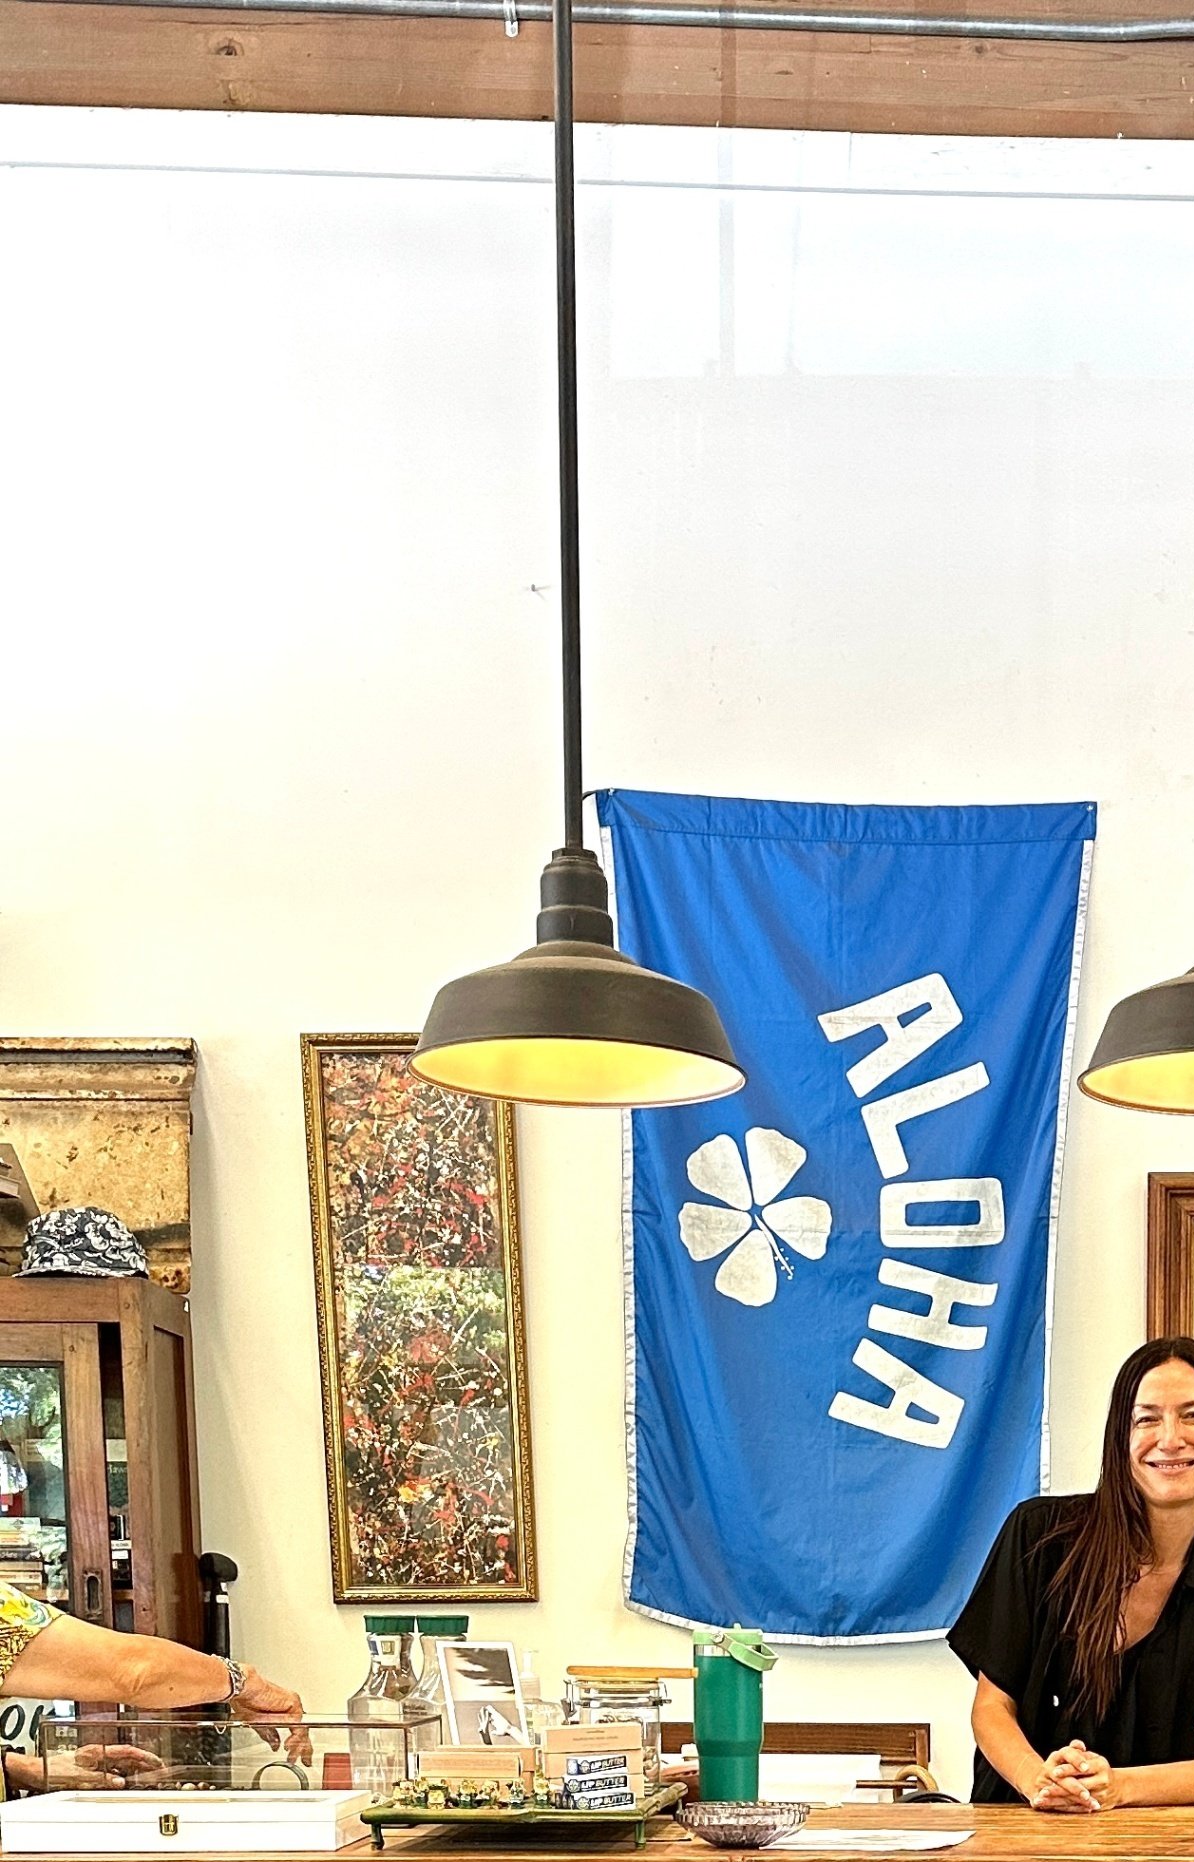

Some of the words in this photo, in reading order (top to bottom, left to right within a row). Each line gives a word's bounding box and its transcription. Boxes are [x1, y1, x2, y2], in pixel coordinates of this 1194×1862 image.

[816, 971, 1008, 1451] ALOHA
[591, 1761, 601, 1769] LIP
[602, 1757, 625, 1767] BUTTER
[582, 1780, 595, 1788] LIP
[596, 1777, 625, 1786] BUTTER
[590, 1798, 603, 1806] LIP
[604, 1794, 632, 1804] BUTTER
